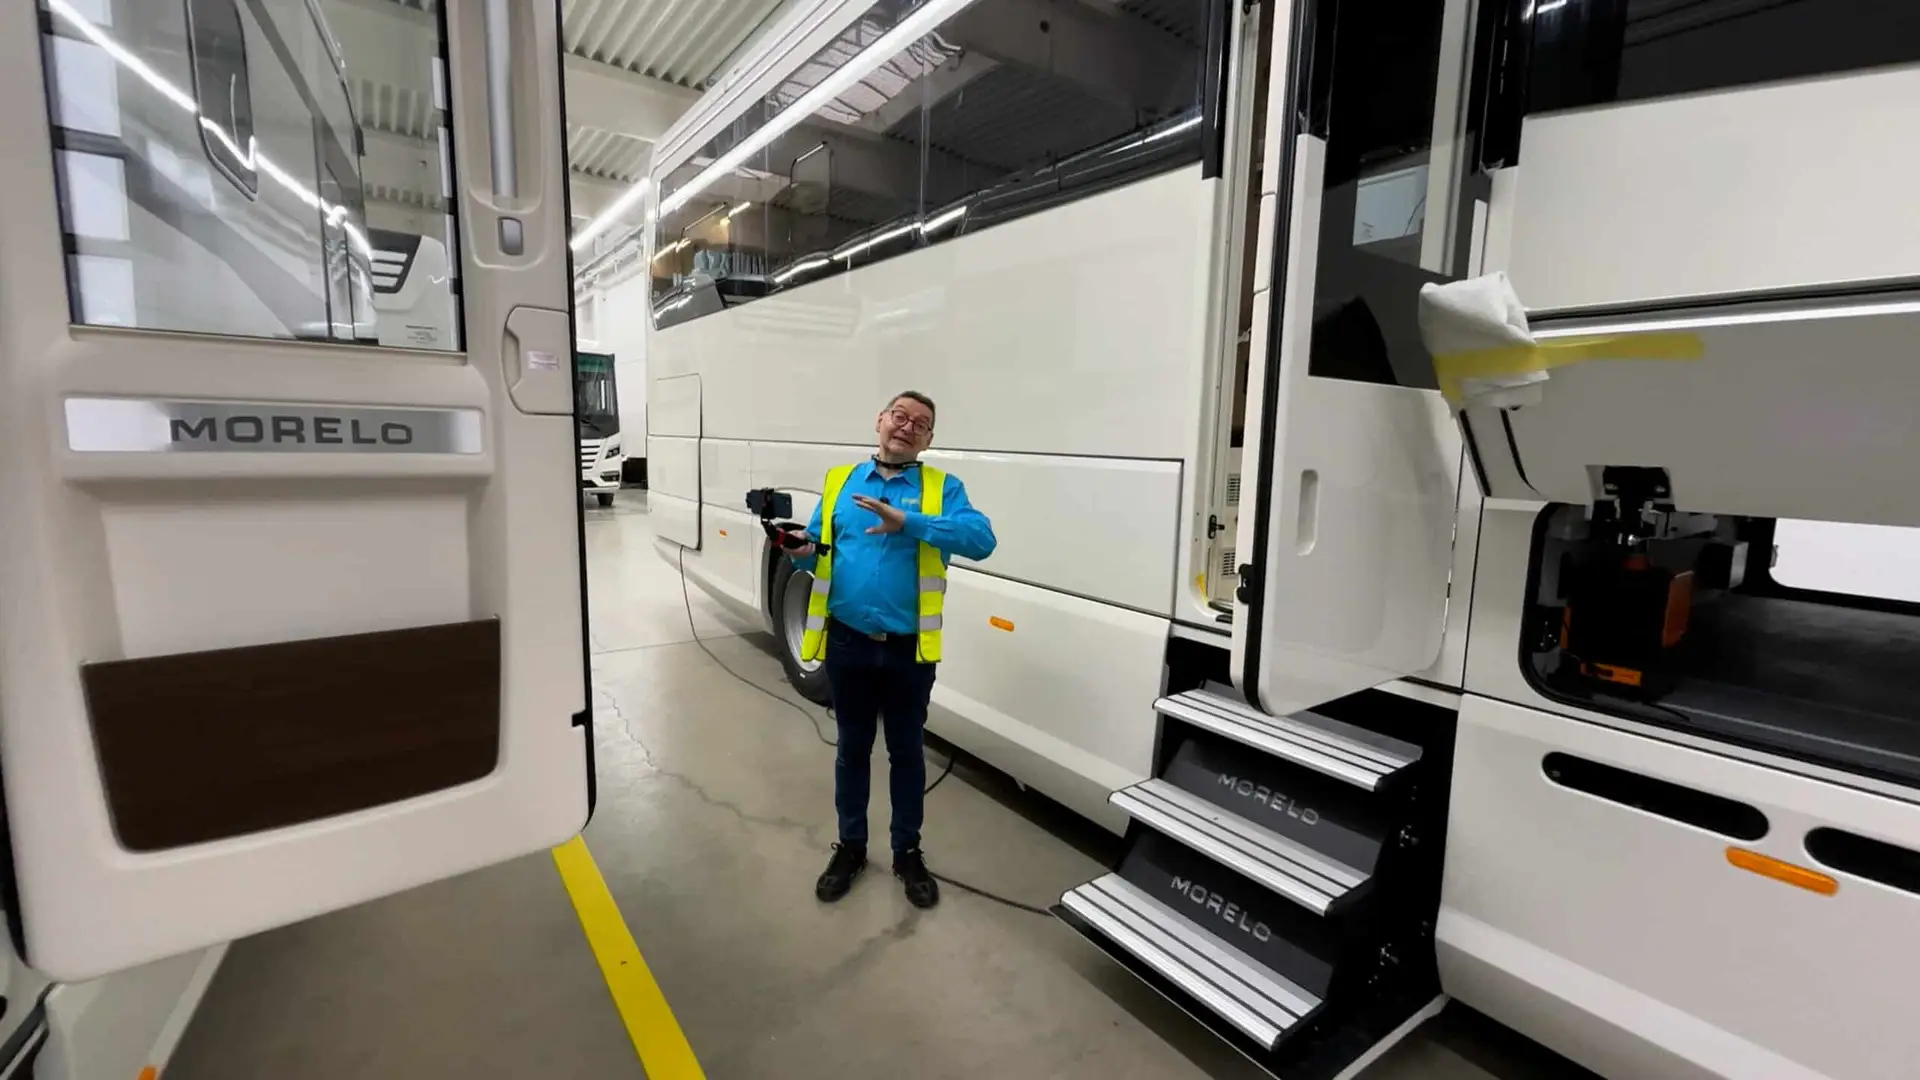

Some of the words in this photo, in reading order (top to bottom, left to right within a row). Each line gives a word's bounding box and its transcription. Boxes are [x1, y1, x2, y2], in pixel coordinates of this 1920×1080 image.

[169, 416, 413, 445] MORELO
[1218, 773, 1320, 826] MORELO
[1170, 875, 1272, 942] MORELO
